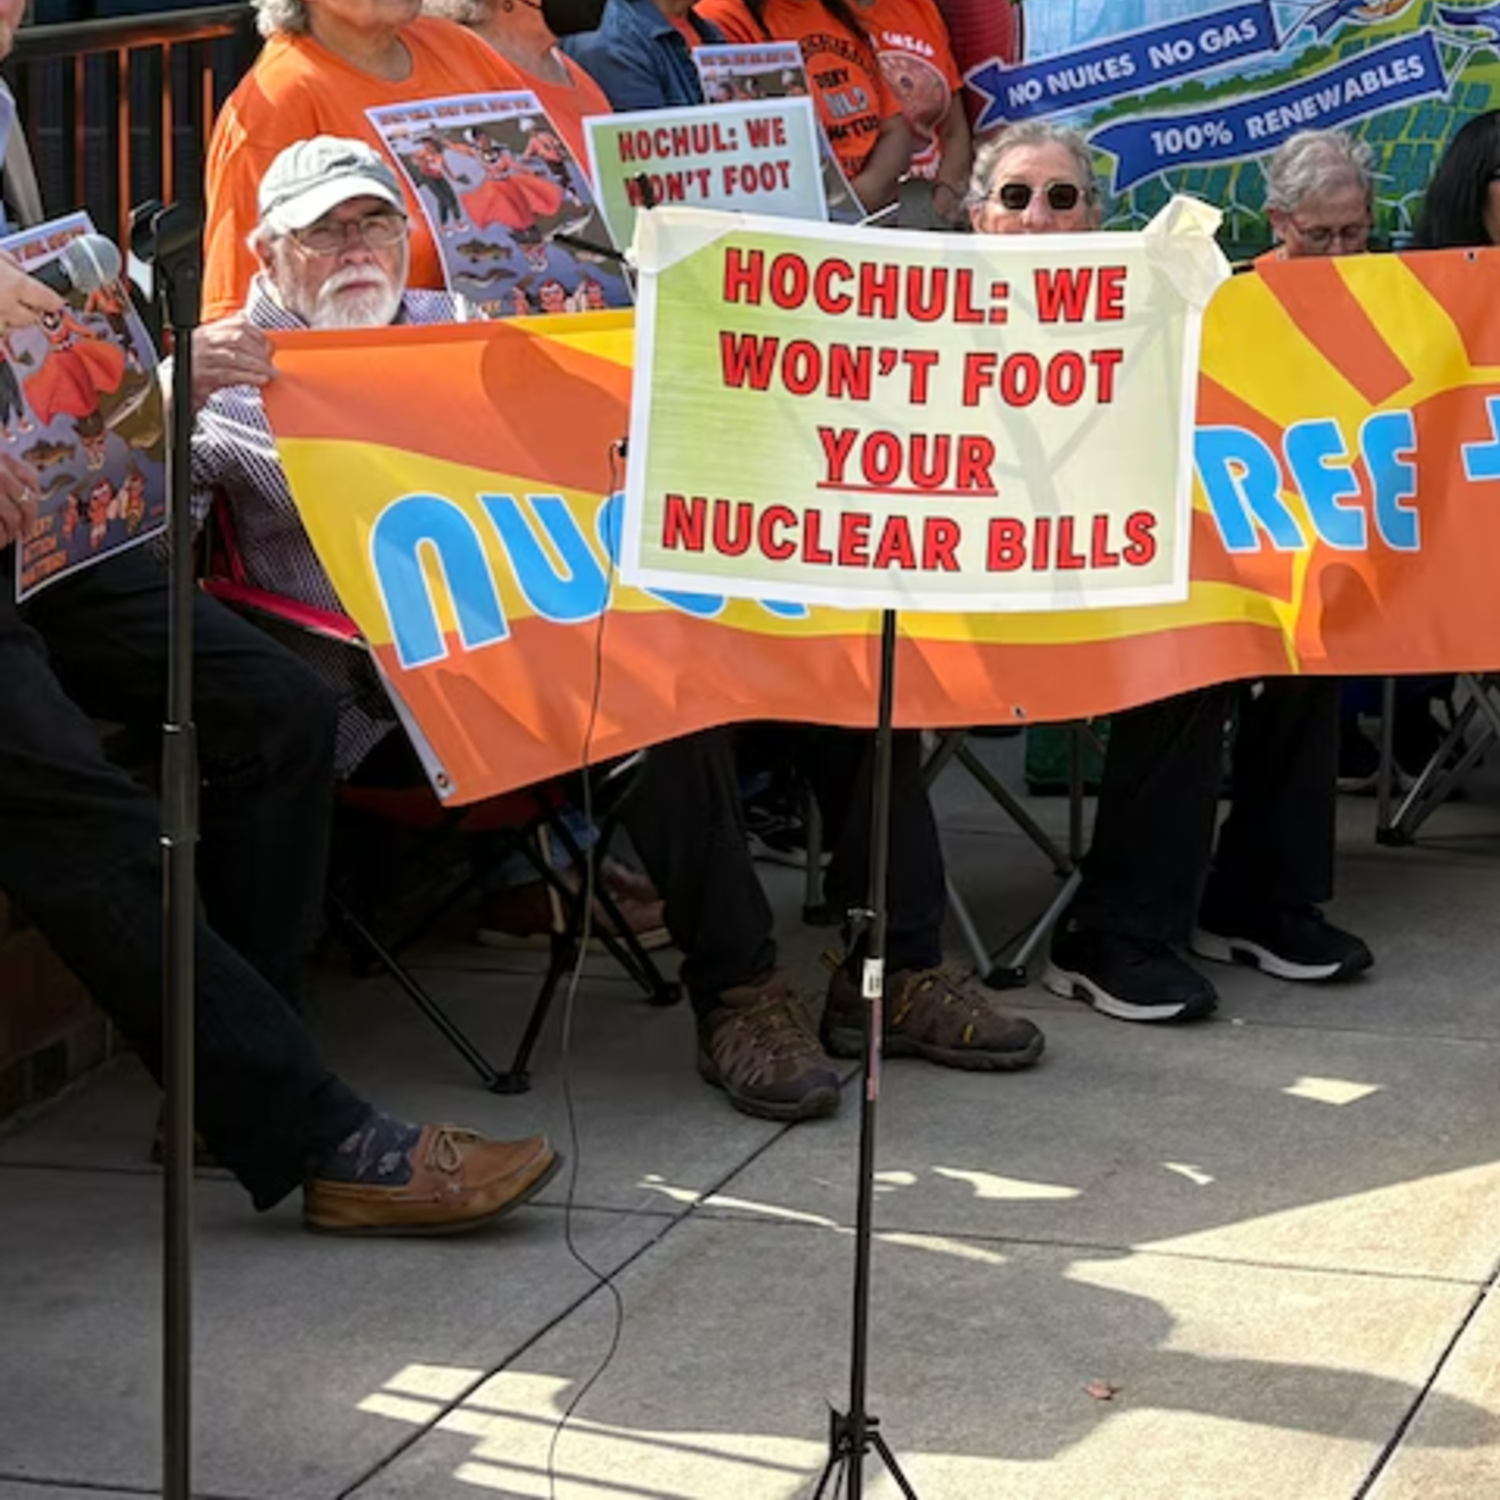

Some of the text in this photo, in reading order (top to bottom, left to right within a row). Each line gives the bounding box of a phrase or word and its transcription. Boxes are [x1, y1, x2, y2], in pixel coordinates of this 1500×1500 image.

[1005, 18, 1259, 109] NO NUKES NO GAS
[617, 126, 738, 163] HOCHUL:
[745, 117, 788, 148] WE
[1150, 54, 1425, 157] 100% RENEWABLES
[722, 160, 791, 196] FOOT
[723, 247, 1128, 325] HOCHUL: WE
[719, 331, 1124, 408] WON'T FOOT
[815, 426, 998, 493] YOUR
[660, 494, 1159, 574] NUCLEAR BILLS
